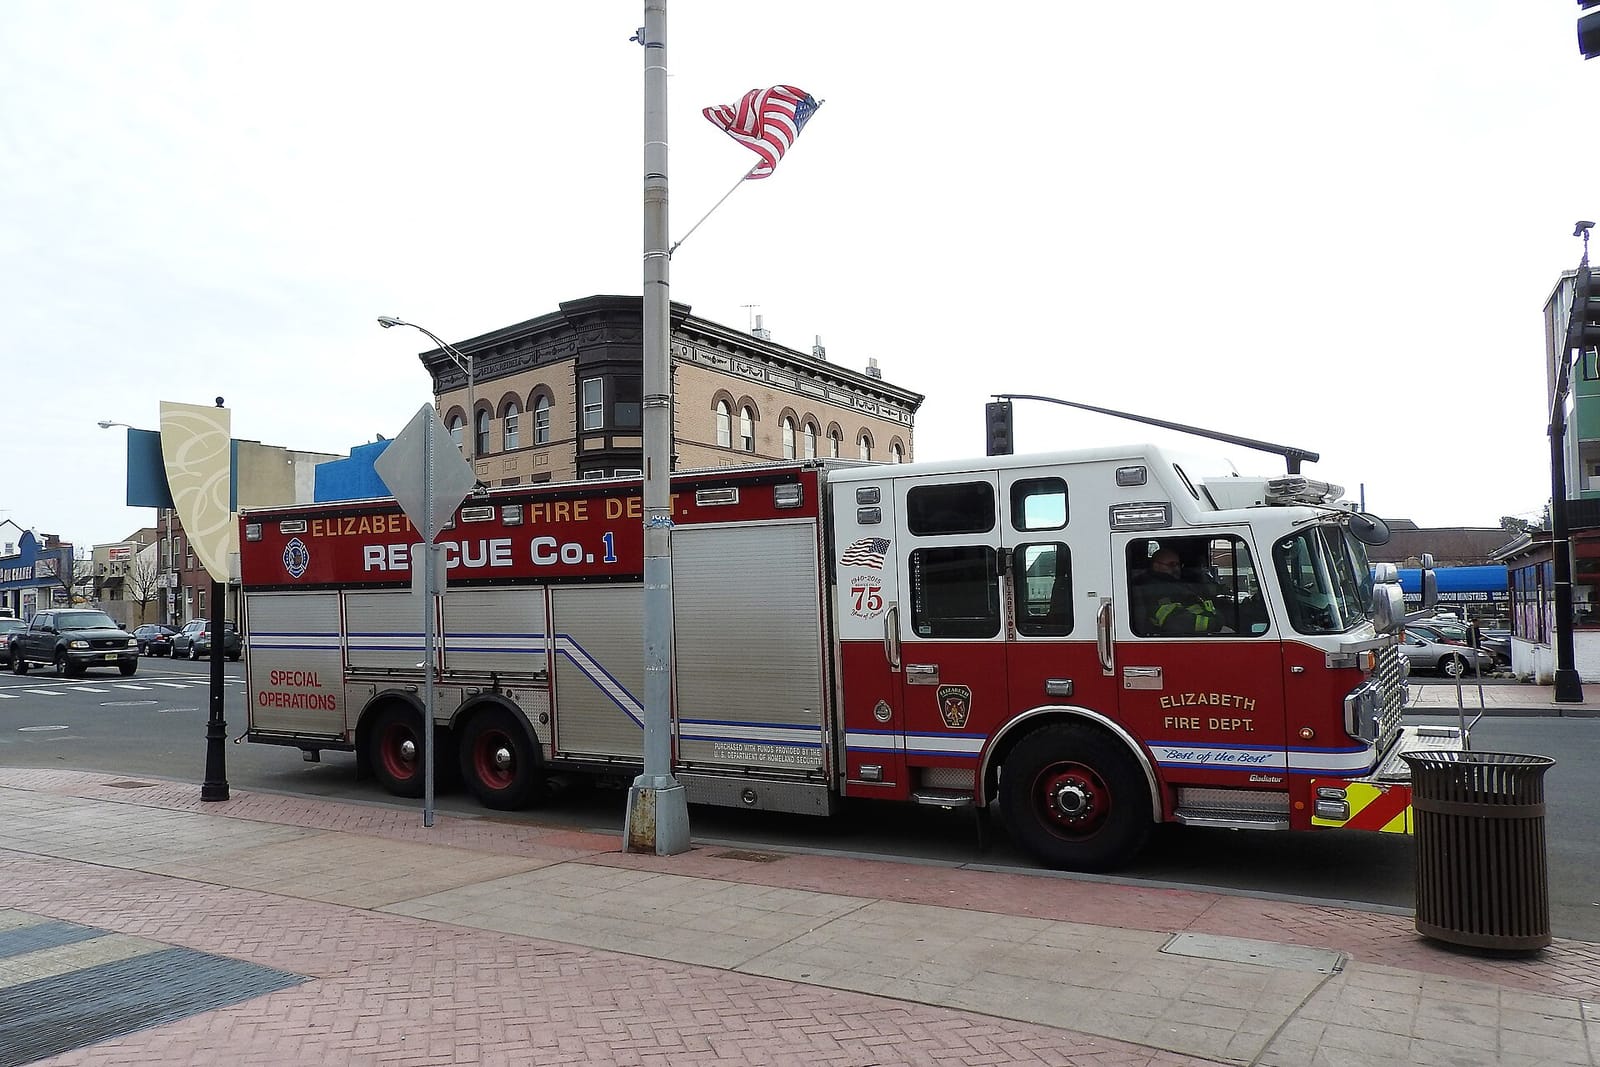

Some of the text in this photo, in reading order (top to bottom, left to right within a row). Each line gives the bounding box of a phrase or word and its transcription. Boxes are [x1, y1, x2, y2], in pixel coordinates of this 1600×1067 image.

[312, 494, 688, 537] ELIZABET FIRE DET.
[364, 531, 617, 571] RECUE Co. 1
[850, 587, 883, 611] 75
[1457, 592, 1488, 601] MINISTRIES
[270, 670, 322, 687] SPECIAL
[259, 691, 336, 710] OPERATIONS
[1160, 693, 1256, 711] ELIZABETH
[1164, 716, 1255, 731] FIRE DEPT.
[714, 742, 742, 751] PURCHASED
[743, 744, 756, 752] WITH
[757, 745, 774, 753] FUNDS
[775, 746, 801, 755] PROVIDED
[802, 748, 809, 756] BY
[727, 751, 758, 760] DEPARTMENT
[760, 753, 766, 761] OF
[767, 754, 795, 763] HOMELAND
[796, 756, 822, 765] SECURITY
[1196, 751, 1213, 765] of
[1214, 751, 1235, 762] the
